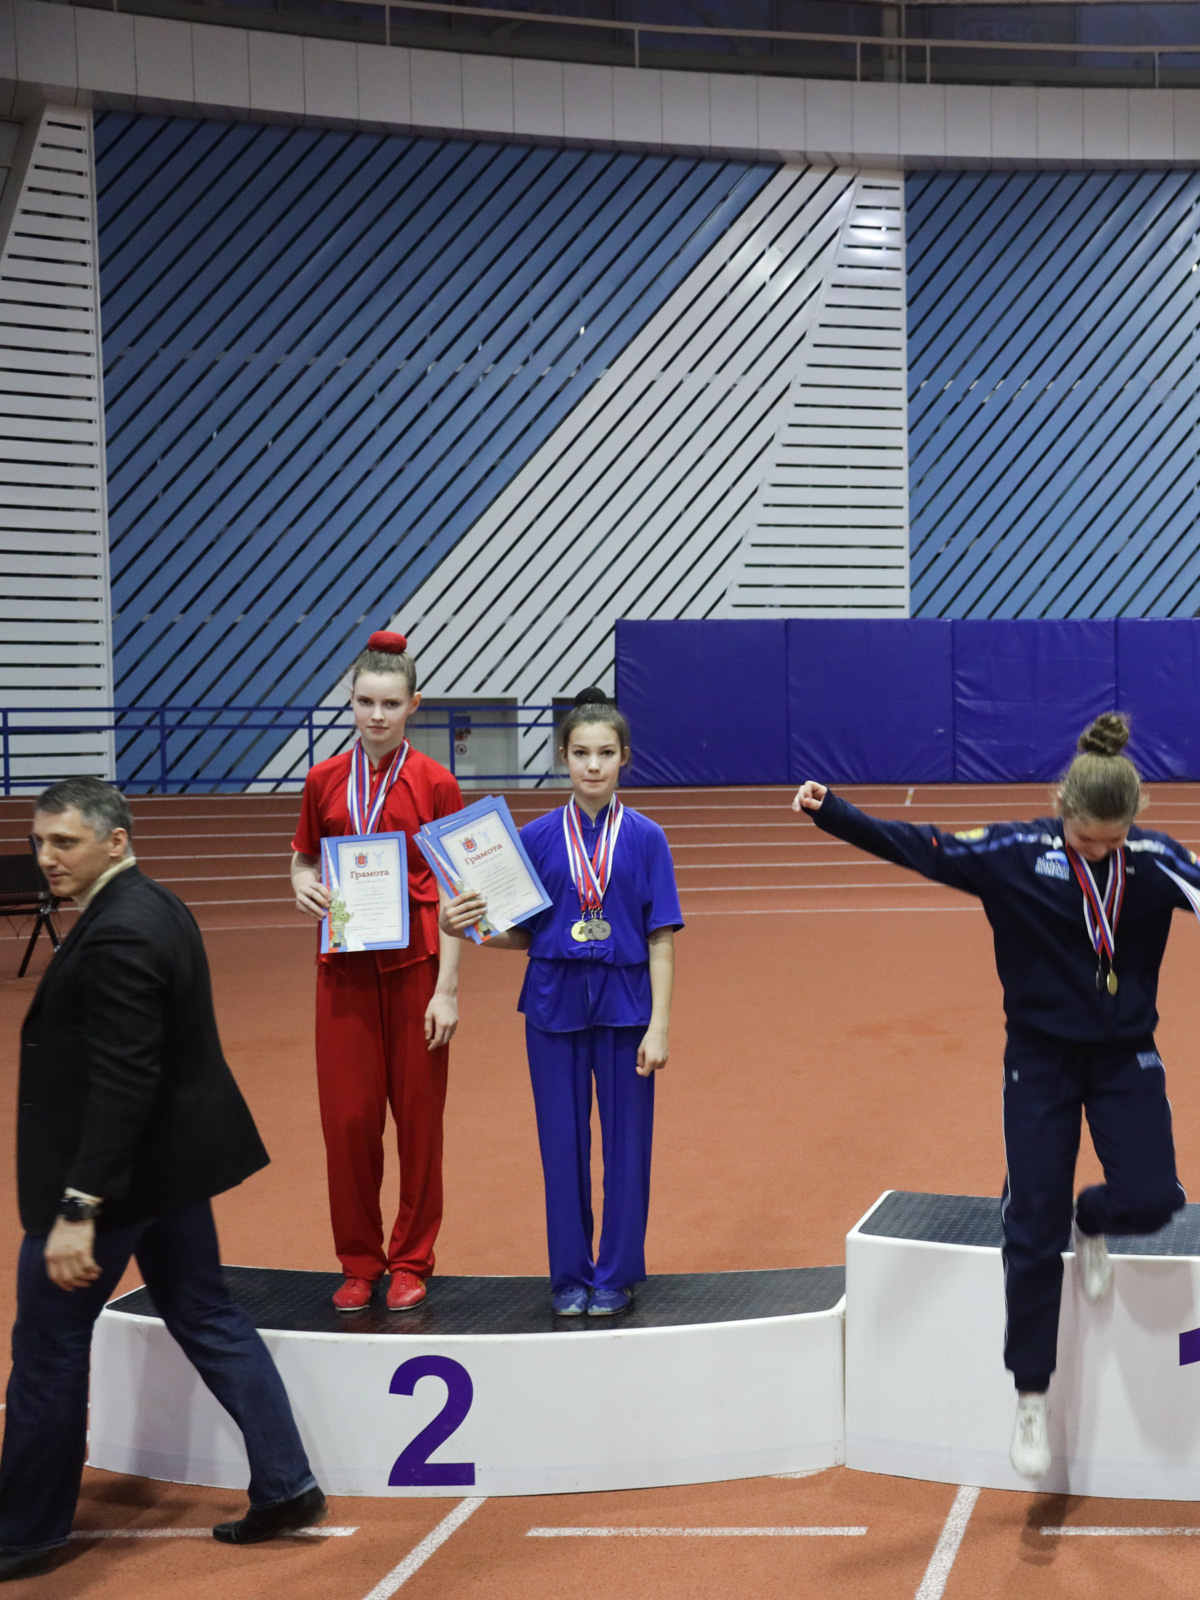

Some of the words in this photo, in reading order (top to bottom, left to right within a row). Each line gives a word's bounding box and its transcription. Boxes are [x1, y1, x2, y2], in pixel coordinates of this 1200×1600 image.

[464, 843, 503, 865] Грамота
[350, 870, 390, 880] Грамота
[388, 1355, 475, 1486] 2
